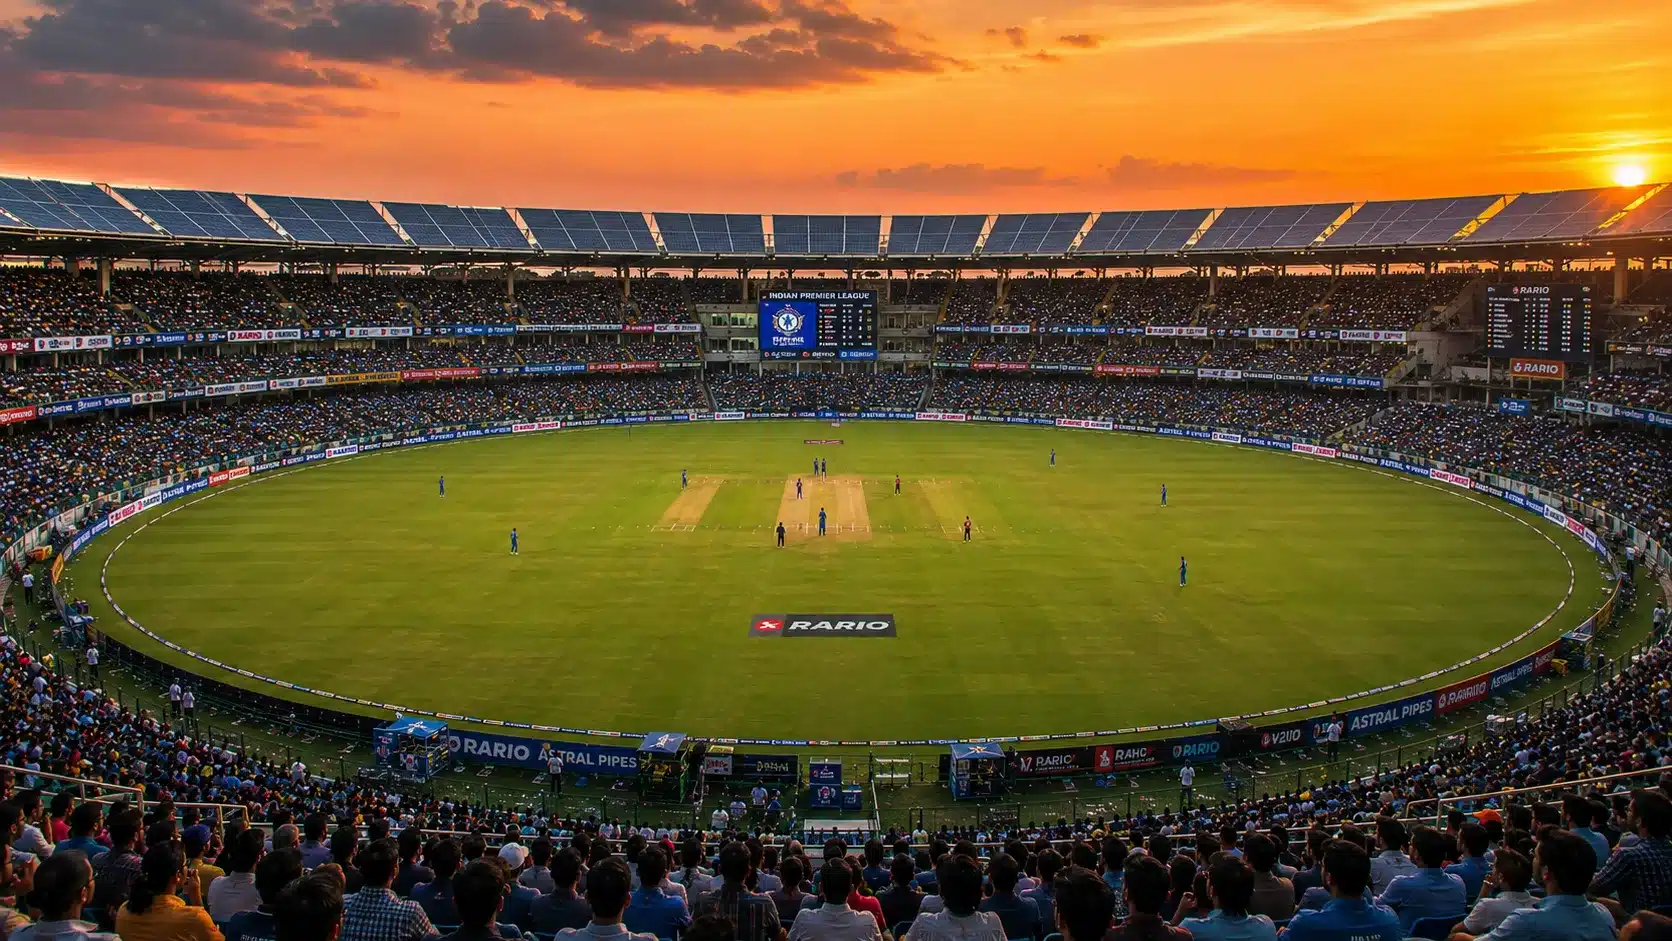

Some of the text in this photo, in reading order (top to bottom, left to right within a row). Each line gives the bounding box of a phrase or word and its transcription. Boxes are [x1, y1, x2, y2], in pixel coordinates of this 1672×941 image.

[1520, 286, 1549, 294] RARIO
[1523, 363, 1558, 374] RARIO
[788, 621, 889, 630] RARIO
[1350, 699, 1433, 731] ASTRAL PIPES
[463, 738, 637, 768] RARIO ASTRAL PIPES
